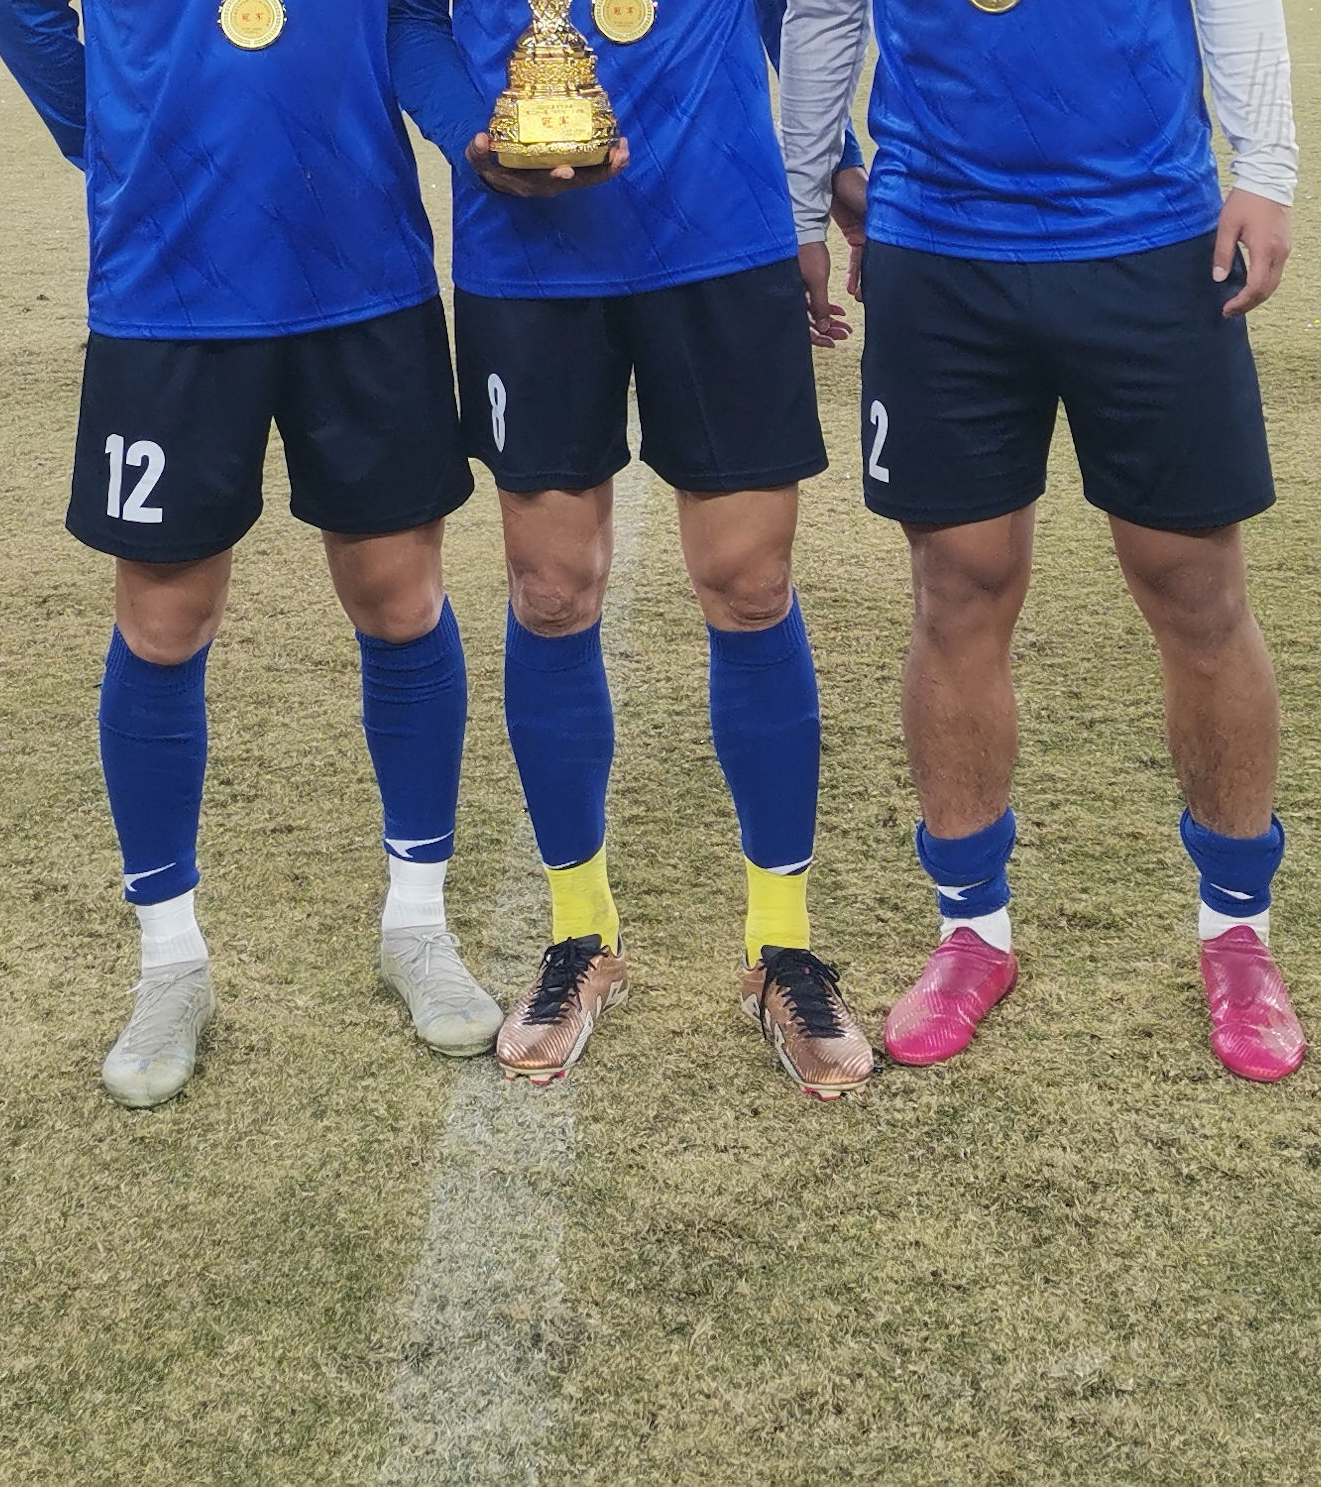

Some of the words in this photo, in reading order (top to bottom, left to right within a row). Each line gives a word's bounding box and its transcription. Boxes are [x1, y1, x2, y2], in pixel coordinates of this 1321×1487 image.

[486, 372, 508, 453] 8
[869, 399, 890, 483] 2
[104, 432, 167, 524] 12
